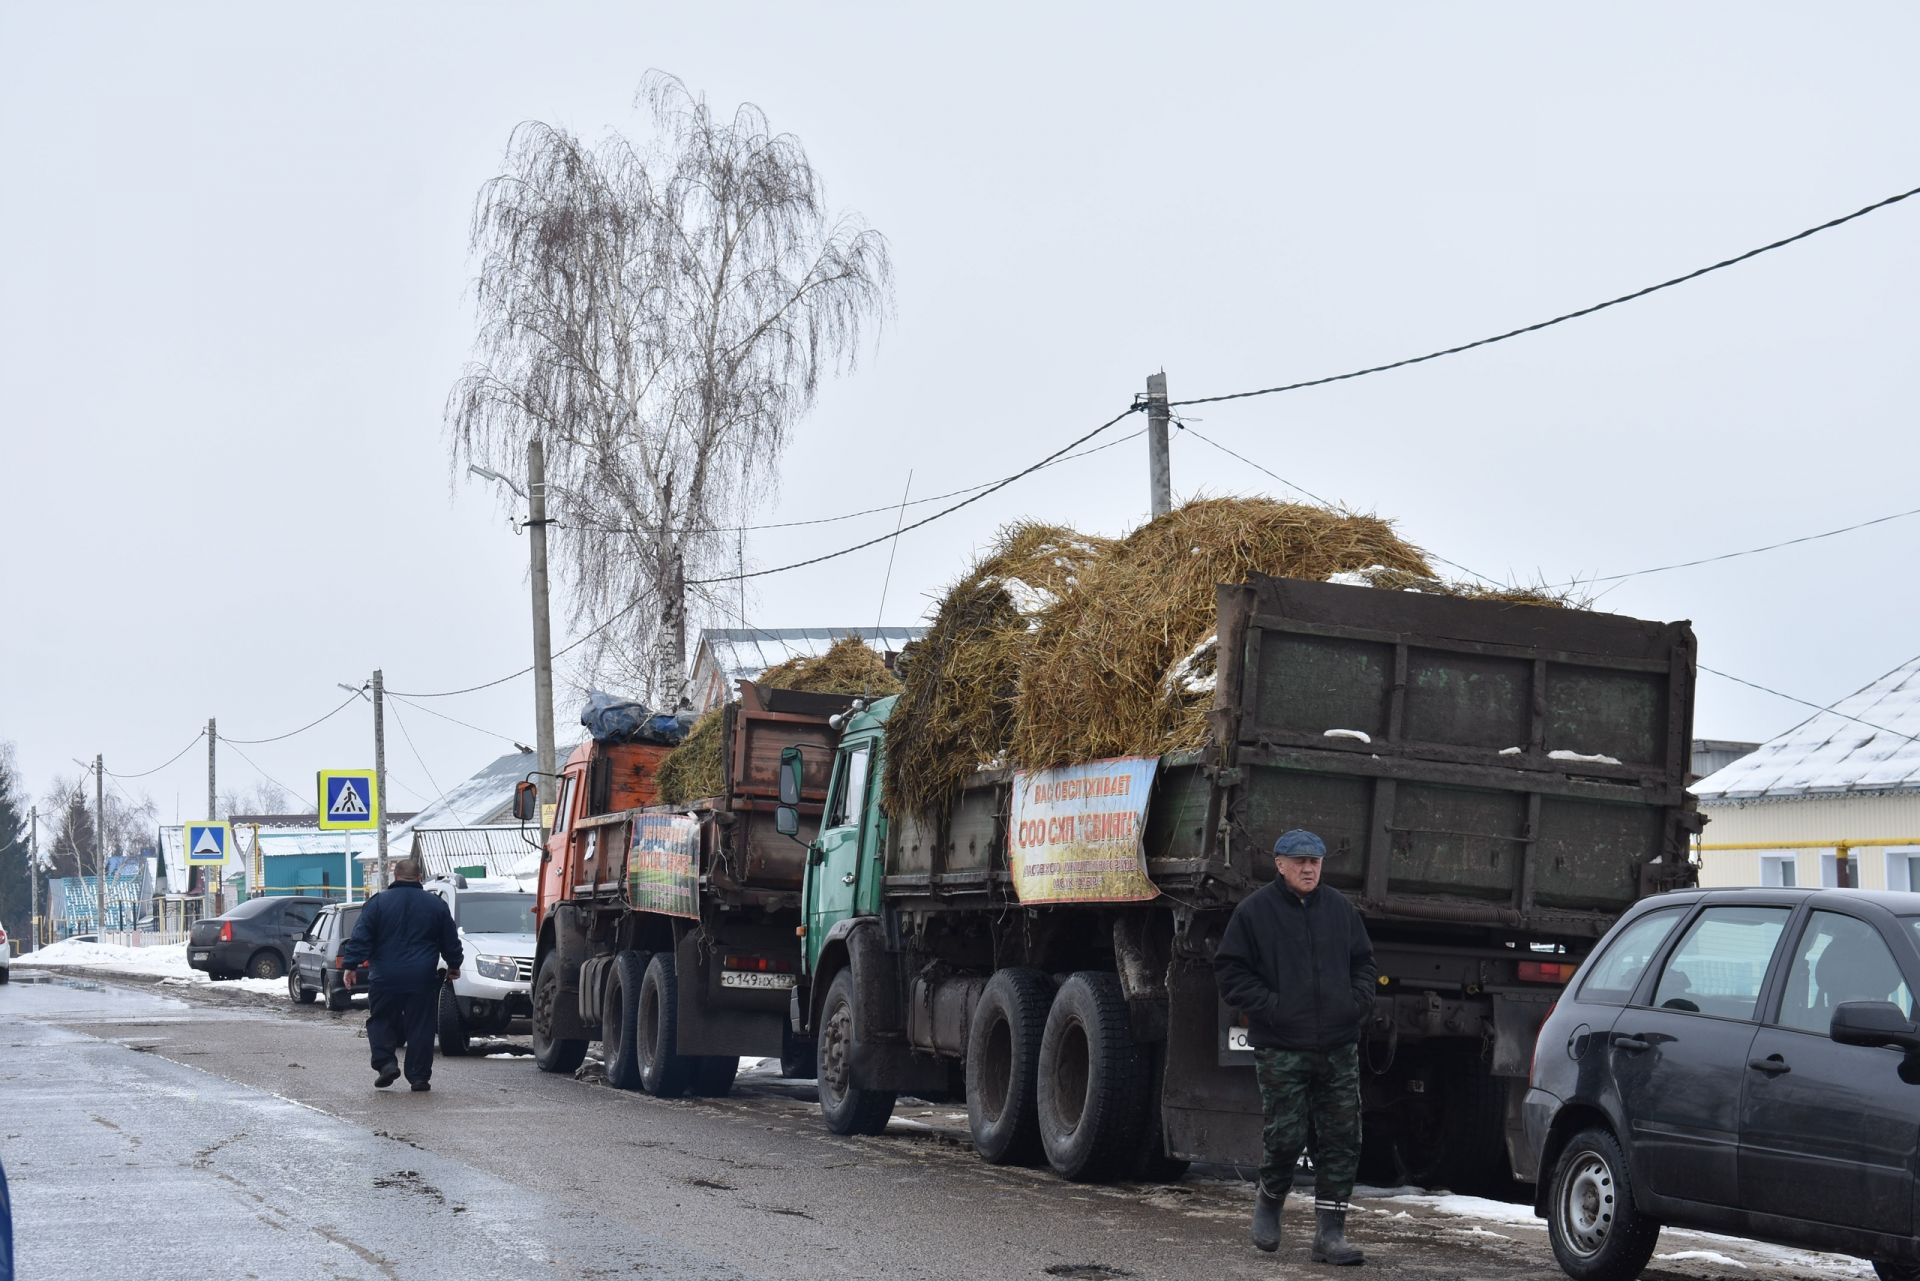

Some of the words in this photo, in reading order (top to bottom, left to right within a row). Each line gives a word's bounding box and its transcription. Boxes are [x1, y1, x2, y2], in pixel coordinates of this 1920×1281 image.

[1034, 783, 1053, 804] ВАС
[1018, 817, 1046, 848] ООО
[1048, 814, 1075, 845] СХП
